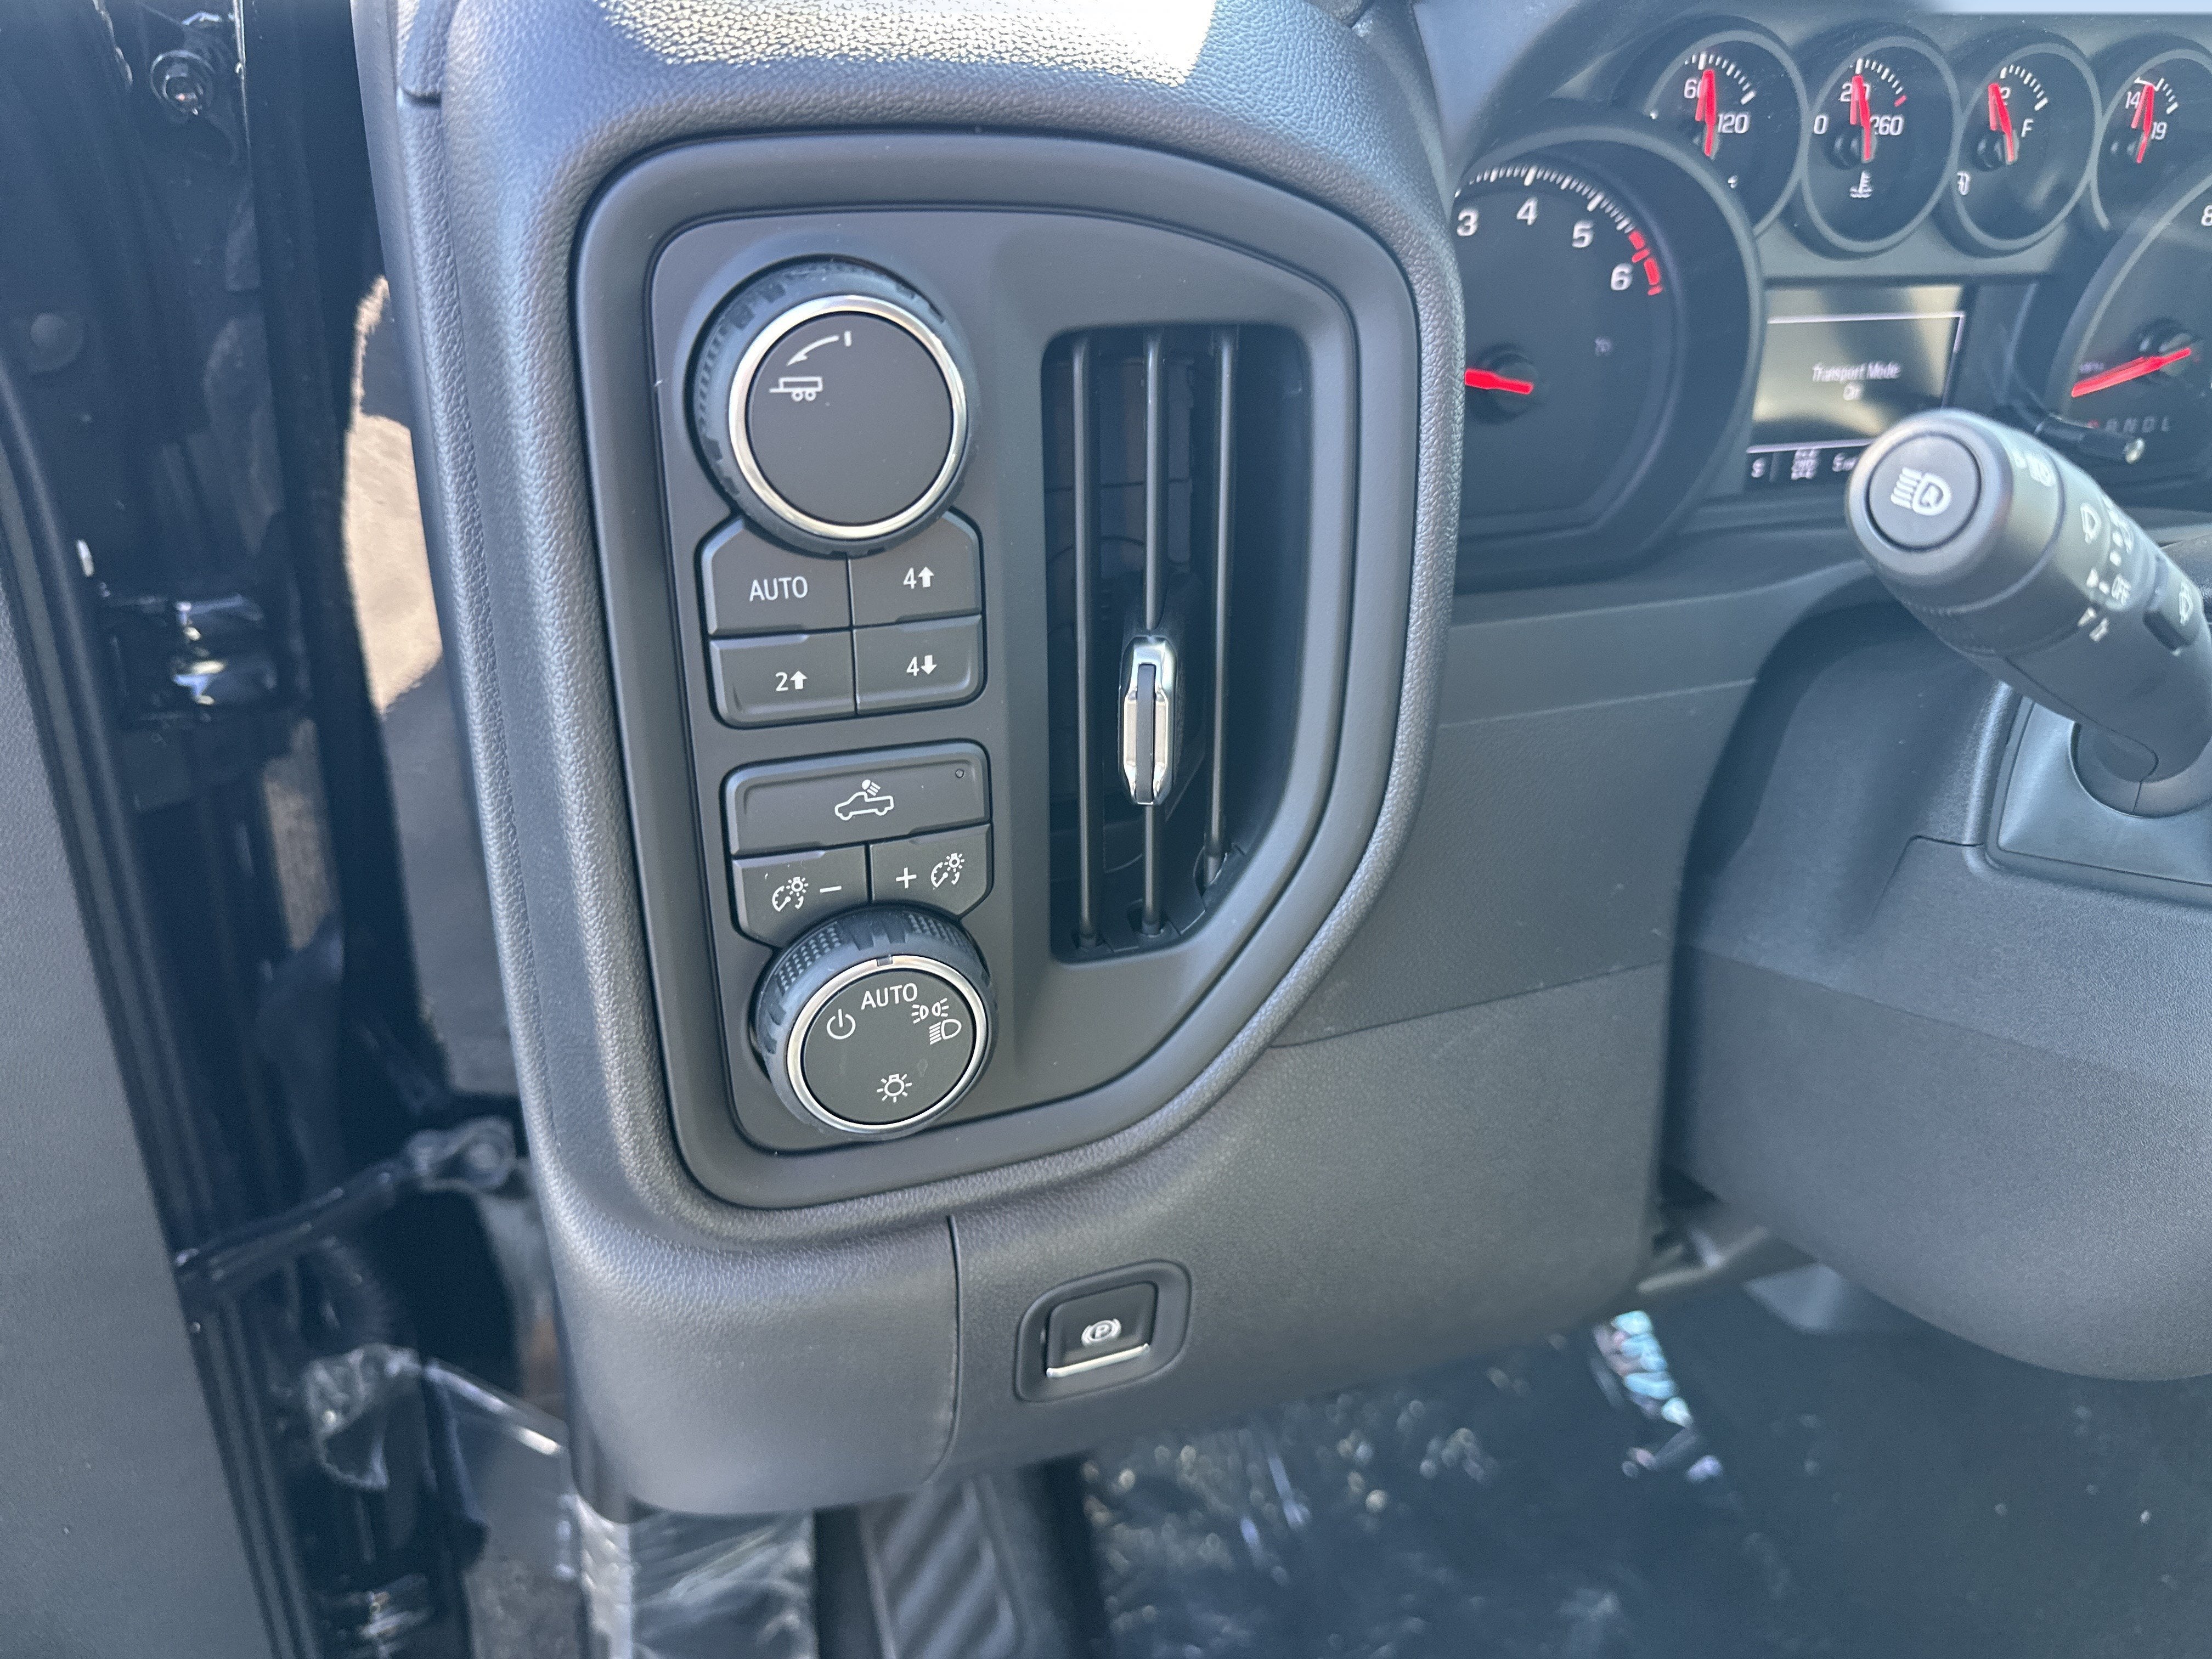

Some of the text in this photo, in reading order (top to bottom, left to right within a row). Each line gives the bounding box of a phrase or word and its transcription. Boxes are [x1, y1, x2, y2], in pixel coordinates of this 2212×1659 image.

[1718, 112, 1750, 134] 120
[2021, 118, 2034, 137] F
[2151, 121, 2167, 140] 19
[1457, 207, 1479, 236] 3
[1516, 197, 1537, 225] 4
[1571, 220, 1594, 249] 5
[1610, 263, 1633, 291] 6
[749, 575, 808, 602] AUTO
[903, 567, 917, 589] 4
[906, 656, 919, 676] 4
[775, 672, 788, 692] 2
[861, 983, 918, 1010] AUTO
